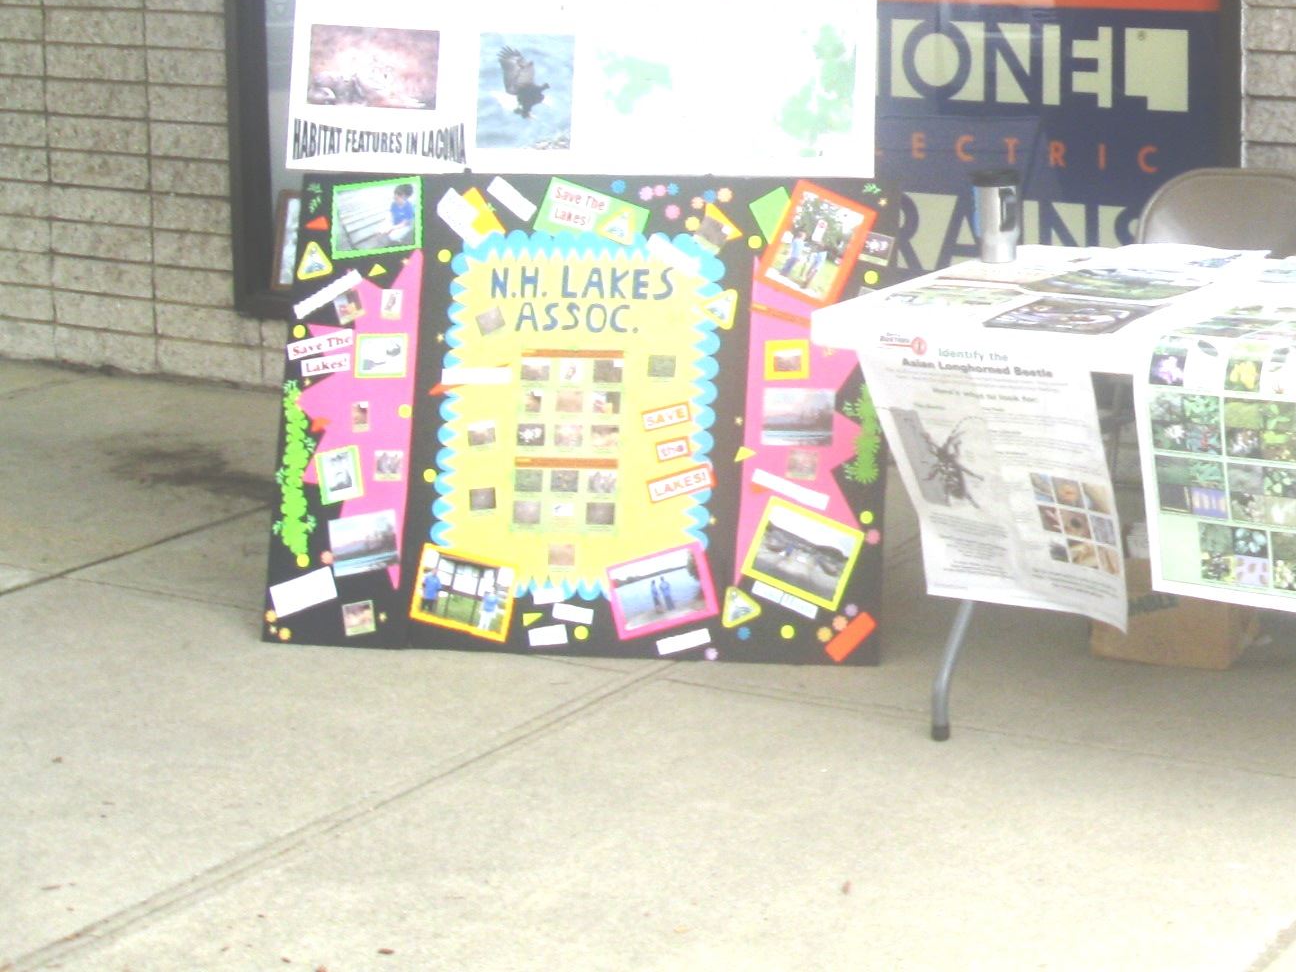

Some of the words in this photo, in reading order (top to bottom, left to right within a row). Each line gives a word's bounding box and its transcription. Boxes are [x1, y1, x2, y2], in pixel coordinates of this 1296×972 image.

[877, 14, 1155, 114] IONEL
[292, 117, 342, 160] HABITAT
[345, 129, 402, 154] FEATURES
[406, 132, 418, 155] IN
[421, 122, 466, 165] LACONIA
[875, 131, 1158, 173] ECTRIC
[554, 186, 582, 205] Save
[585, 195, 605, 210] The
[491, 266, 547, 299] N.H.
[561, 265, 674, 300] LAKES
[514, 302, 639, 333] ASSOC.
[292, 341, 323, 356] Save
[327, 336, 351, 349] The
[938, 348, 984, 362] Identify
[989, 352, 1009, 362] the
[306, 357, 347, 373] Lakes!
[902, 357, 936, 369] Asian
[938, 361, 1009, 376] Longhorned
[1013, 366, 1053, 378] Beetle
[646, 407, 685, 426] SAVE
[654, 472, 706, 496] LAKES!
